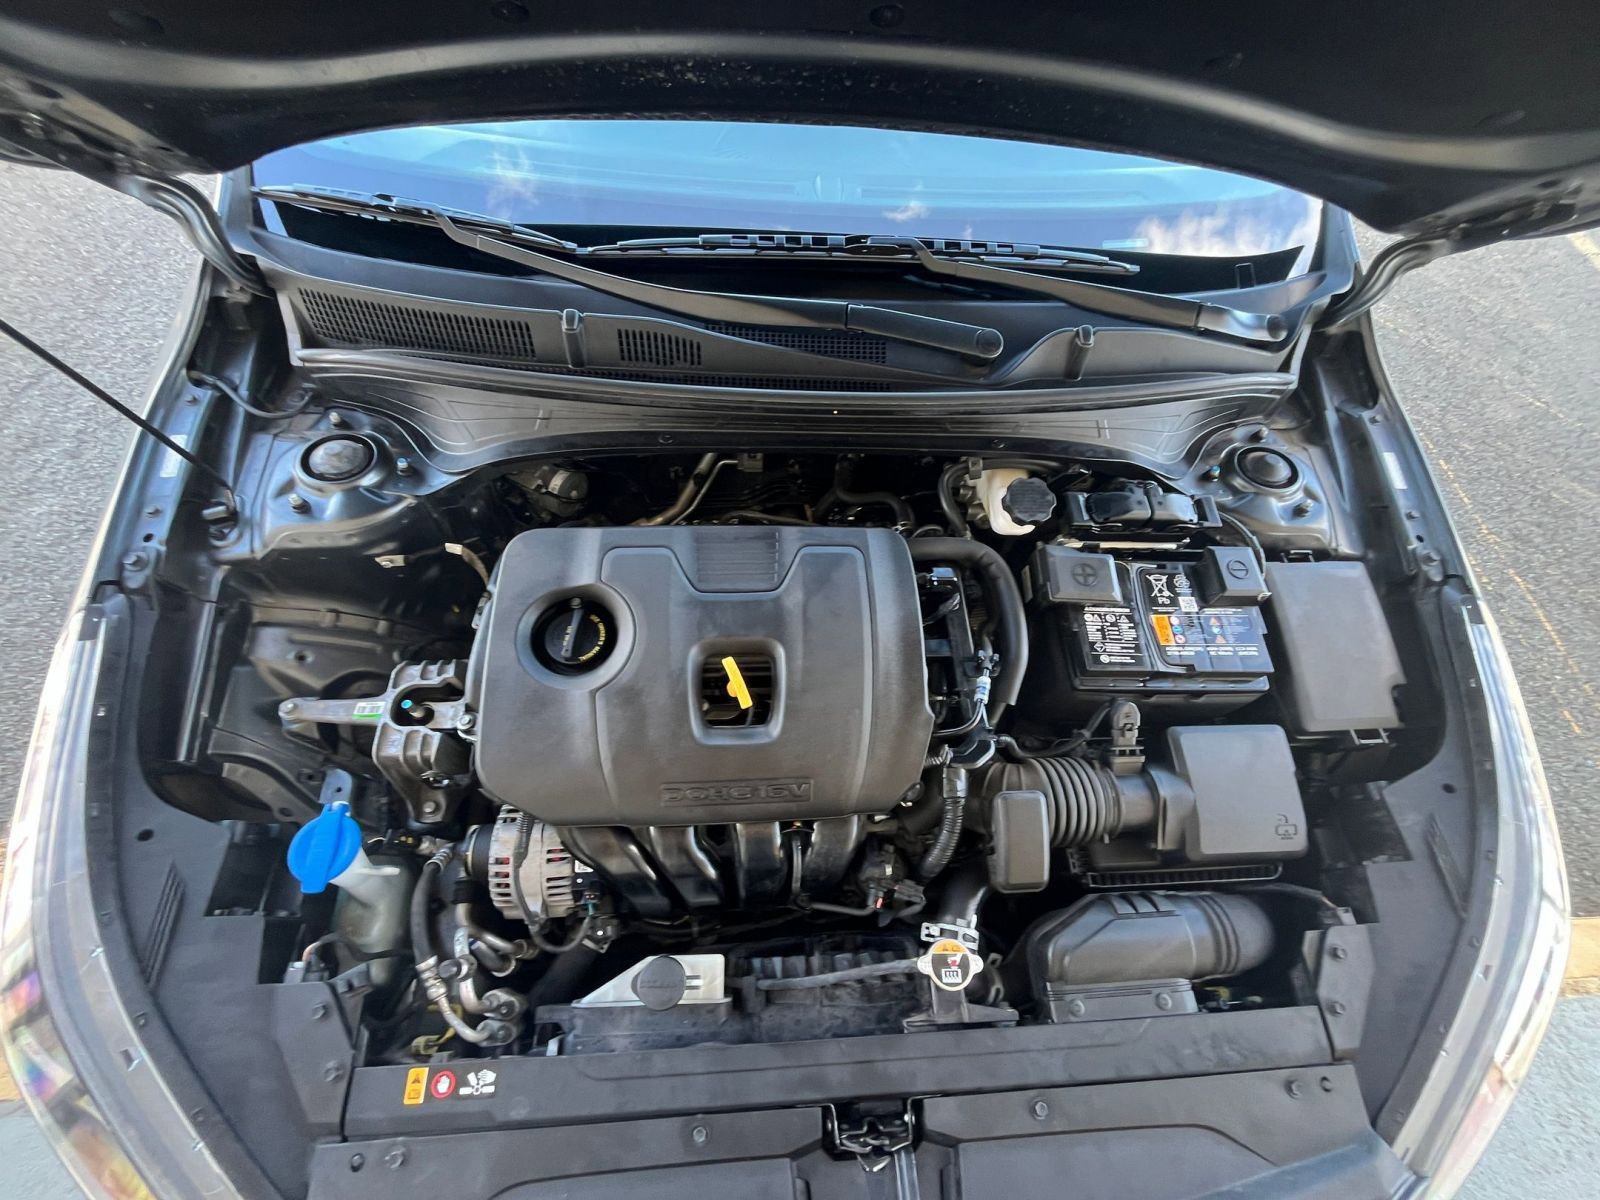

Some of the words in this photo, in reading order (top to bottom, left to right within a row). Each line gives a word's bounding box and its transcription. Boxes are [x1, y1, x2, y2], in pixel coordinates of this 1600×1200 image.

[1157, 597, 1171, 605] Pb
[662, 785, 752, 802] DOHC
[758, 783, 810, 799] 16V
